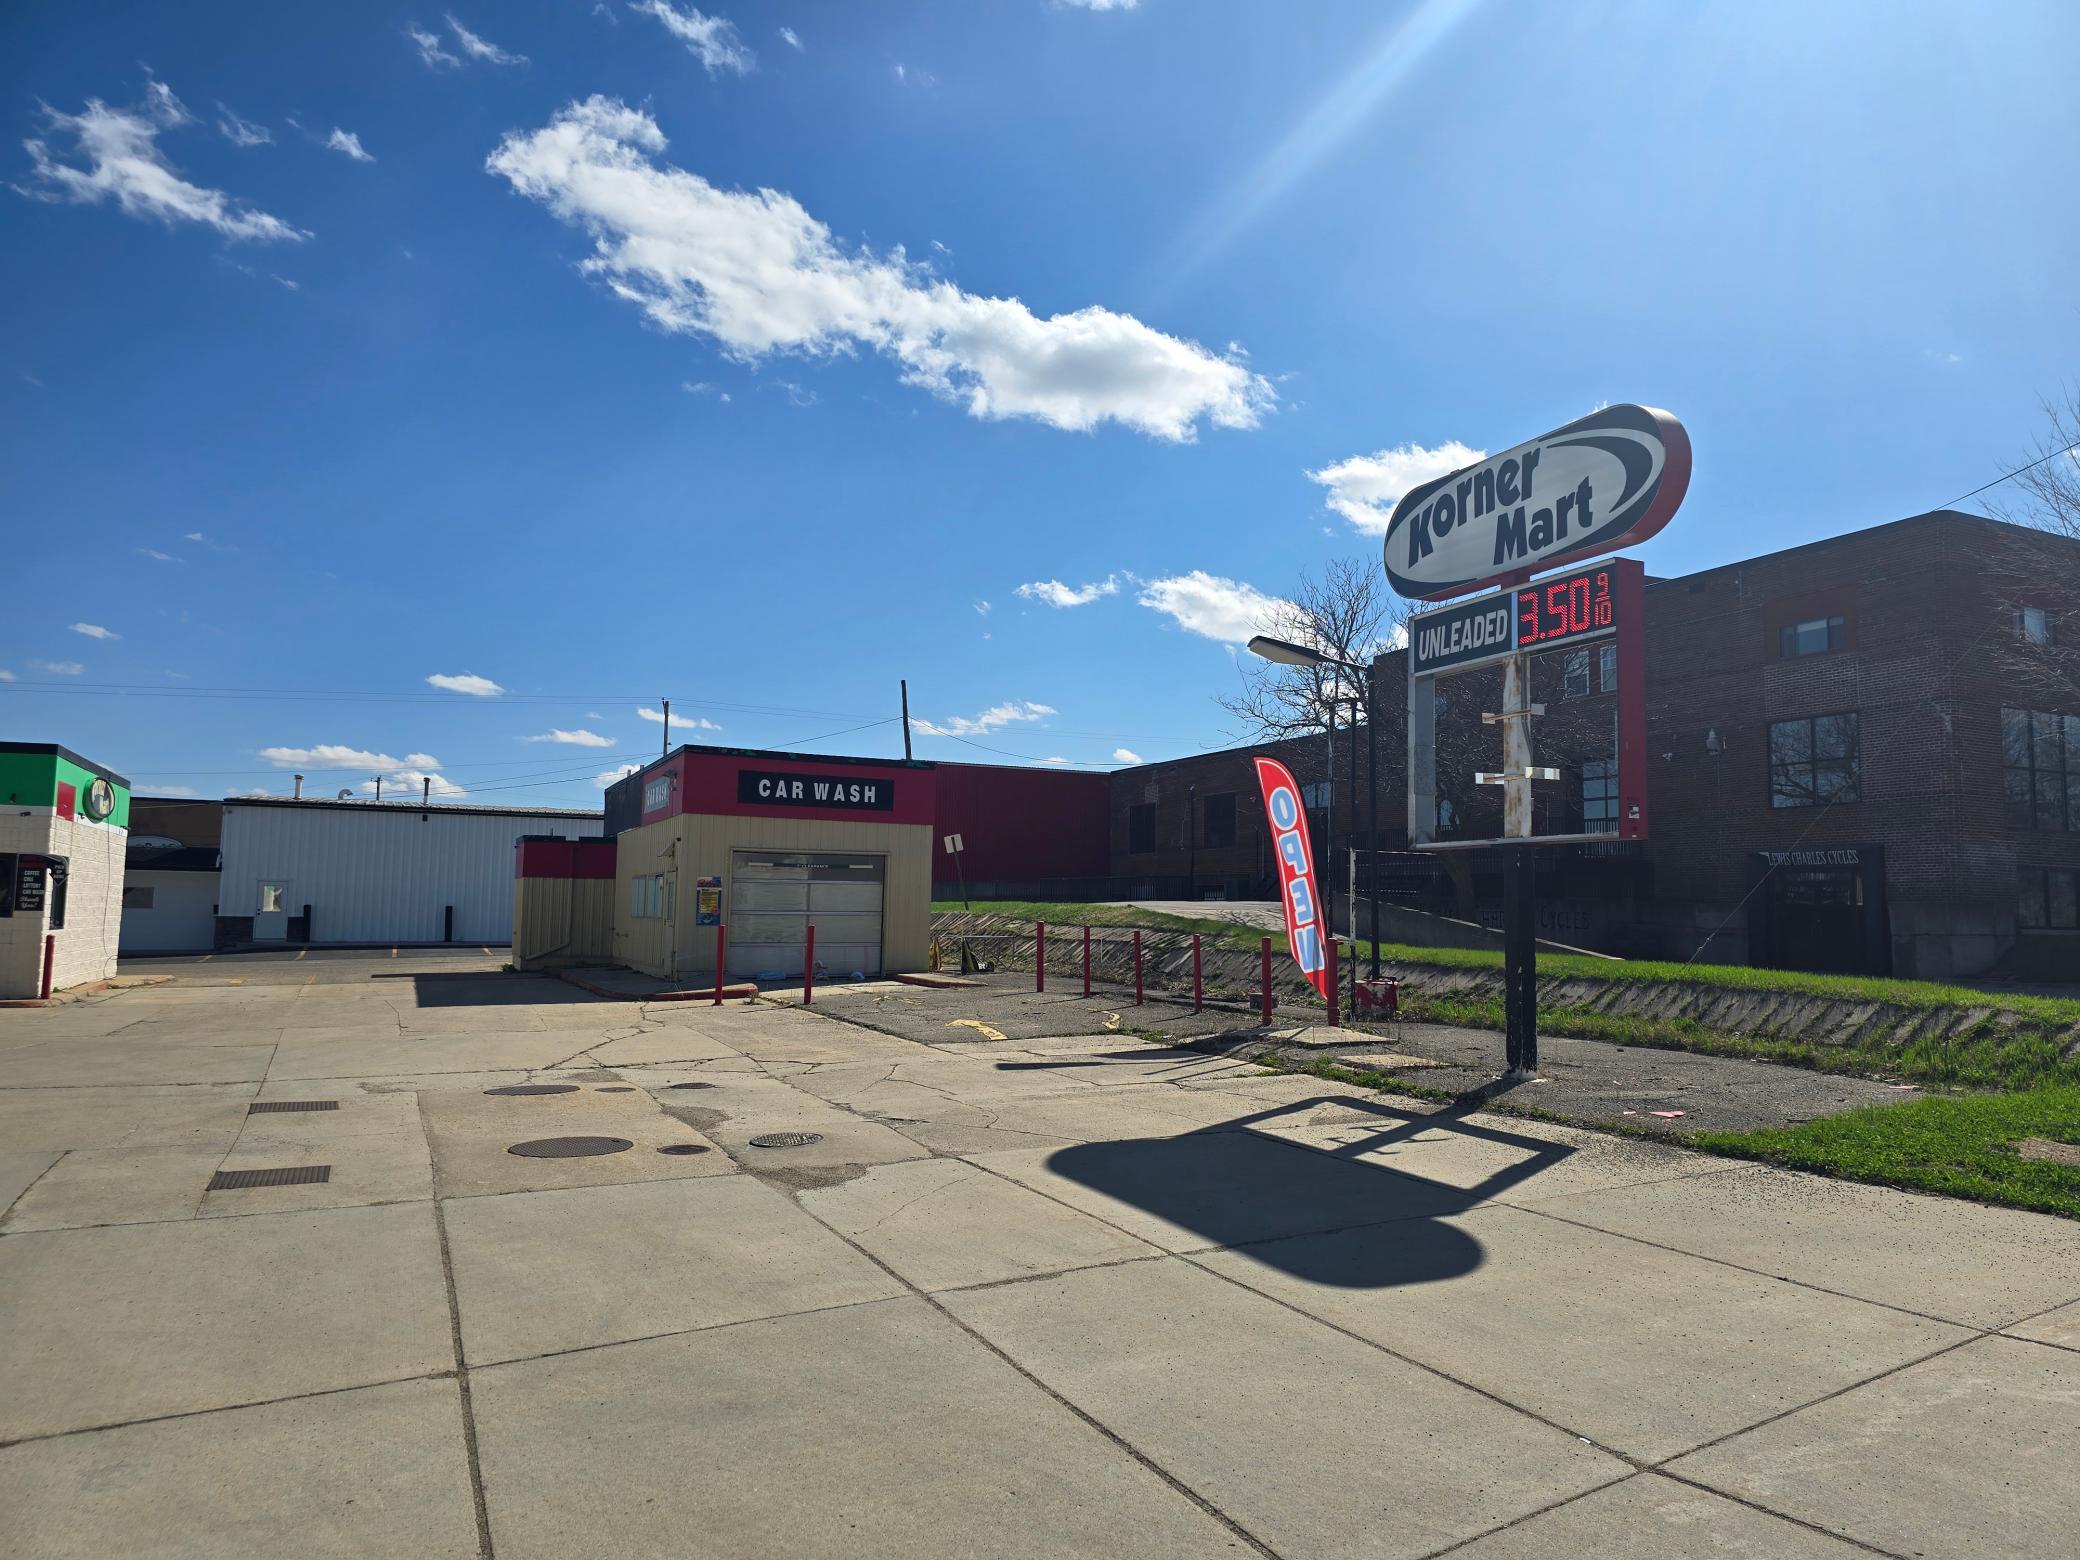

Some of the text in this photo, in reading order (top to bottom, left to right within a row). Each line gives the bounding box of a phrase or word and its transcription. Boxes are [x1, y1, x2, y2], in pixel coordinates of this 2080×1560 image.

[1408, 448, 1541, 569] Korner
[1493, 475, 1594, 566] Mart
[1418, 578, 1590, 662] UNLEADED 3.50
[758, 778, 877, 804] CAR WASH
[1767, 849, 1859, 866] LEWIS CHARLES CYCLES
